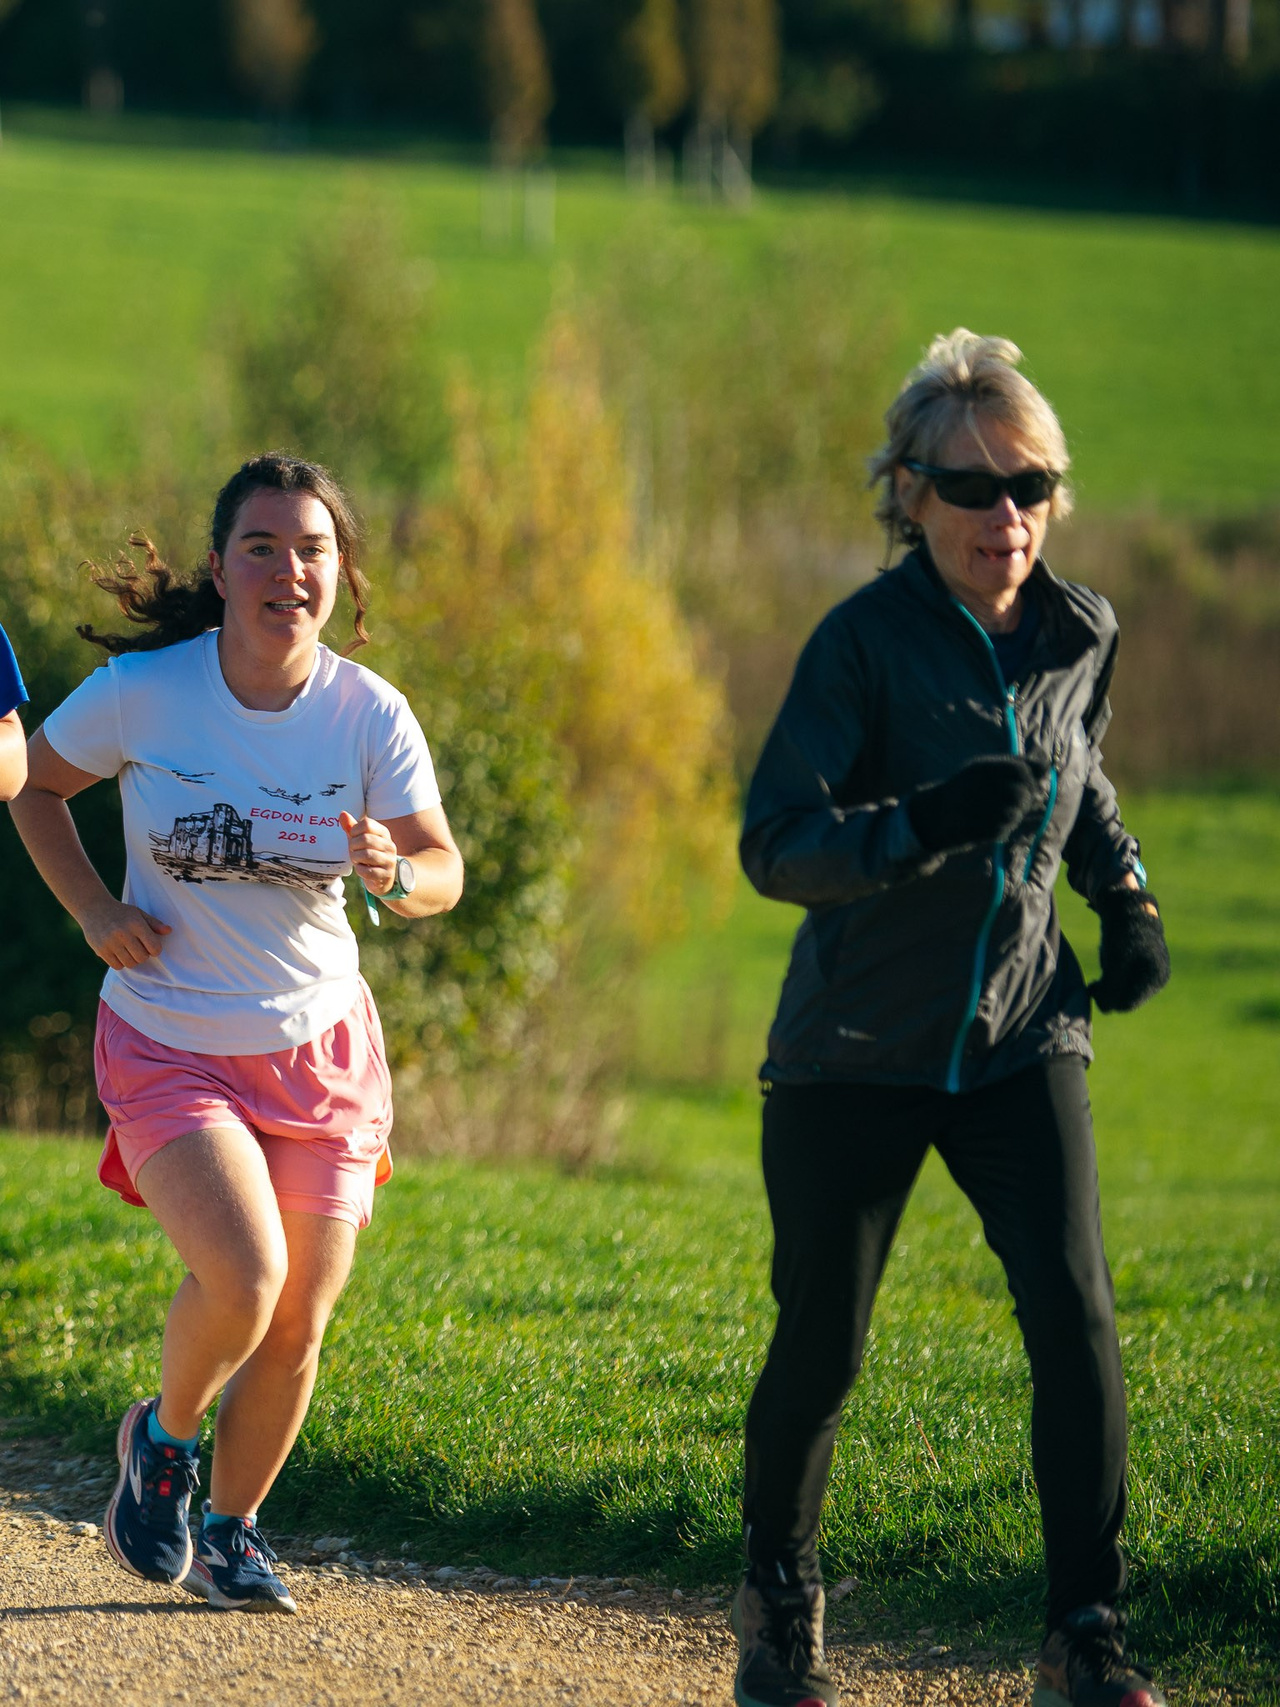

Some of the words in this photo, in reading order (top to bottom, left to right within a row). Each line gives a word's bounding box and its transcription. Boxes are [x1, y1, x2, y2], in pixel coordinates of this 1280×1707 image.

[250, 807, 304, 824] EGDON
[309, 815, 340, 828] EASY
[278, 831, 317, 844] 2018
